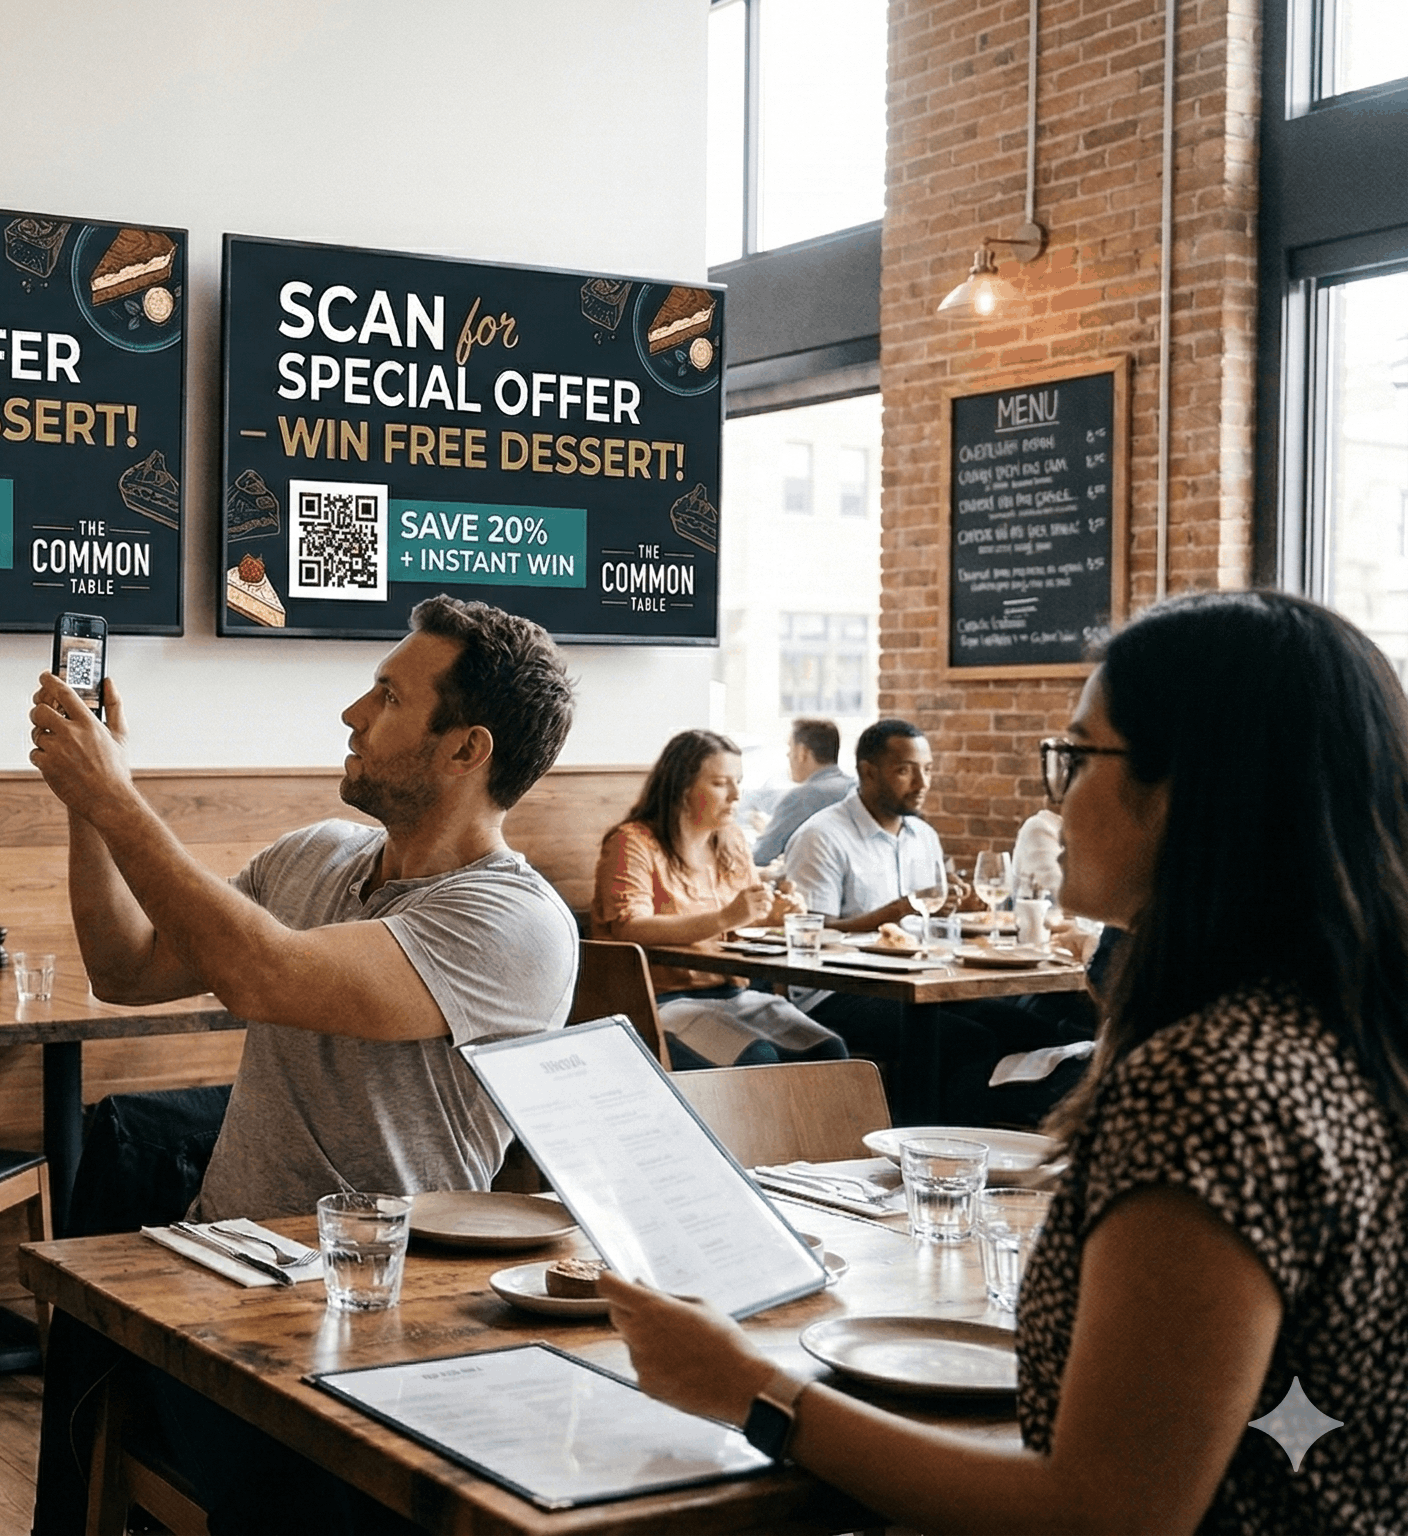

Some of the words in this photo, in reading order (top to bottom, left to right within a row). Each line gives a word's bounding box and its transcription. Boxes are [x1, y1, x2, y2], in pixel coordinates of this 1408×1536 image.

[278, 281, 445, 351] SCAN
[455, 296, 519, 366] for
[277, 352, 482, 413] SPECIAL
[494, 370, 641, 425] OFFER
[996, 389, 1059, 428] MENU
[277, 415, 368, 462] WIN
[384, 423, 487, 469] FREE
[501, 431, 685, 482] DESSERT!
[78, 520, 106, 537] THE
[400, 510, 479, 542] SAVE
[487, 515, 548, 545] 20%
[32, 538, 150, 577] COMMON
[400, 551, 414, 567] +
[421, 548, 522, 574] INSTANT
[526, 553, 574, 577] WIN
[638, 544, 660, 560] THE
[70, 578, 114, 595] TABLE
[602, 561, 694, 595] COMMON
[630, 596, 666, 612] TABLE
